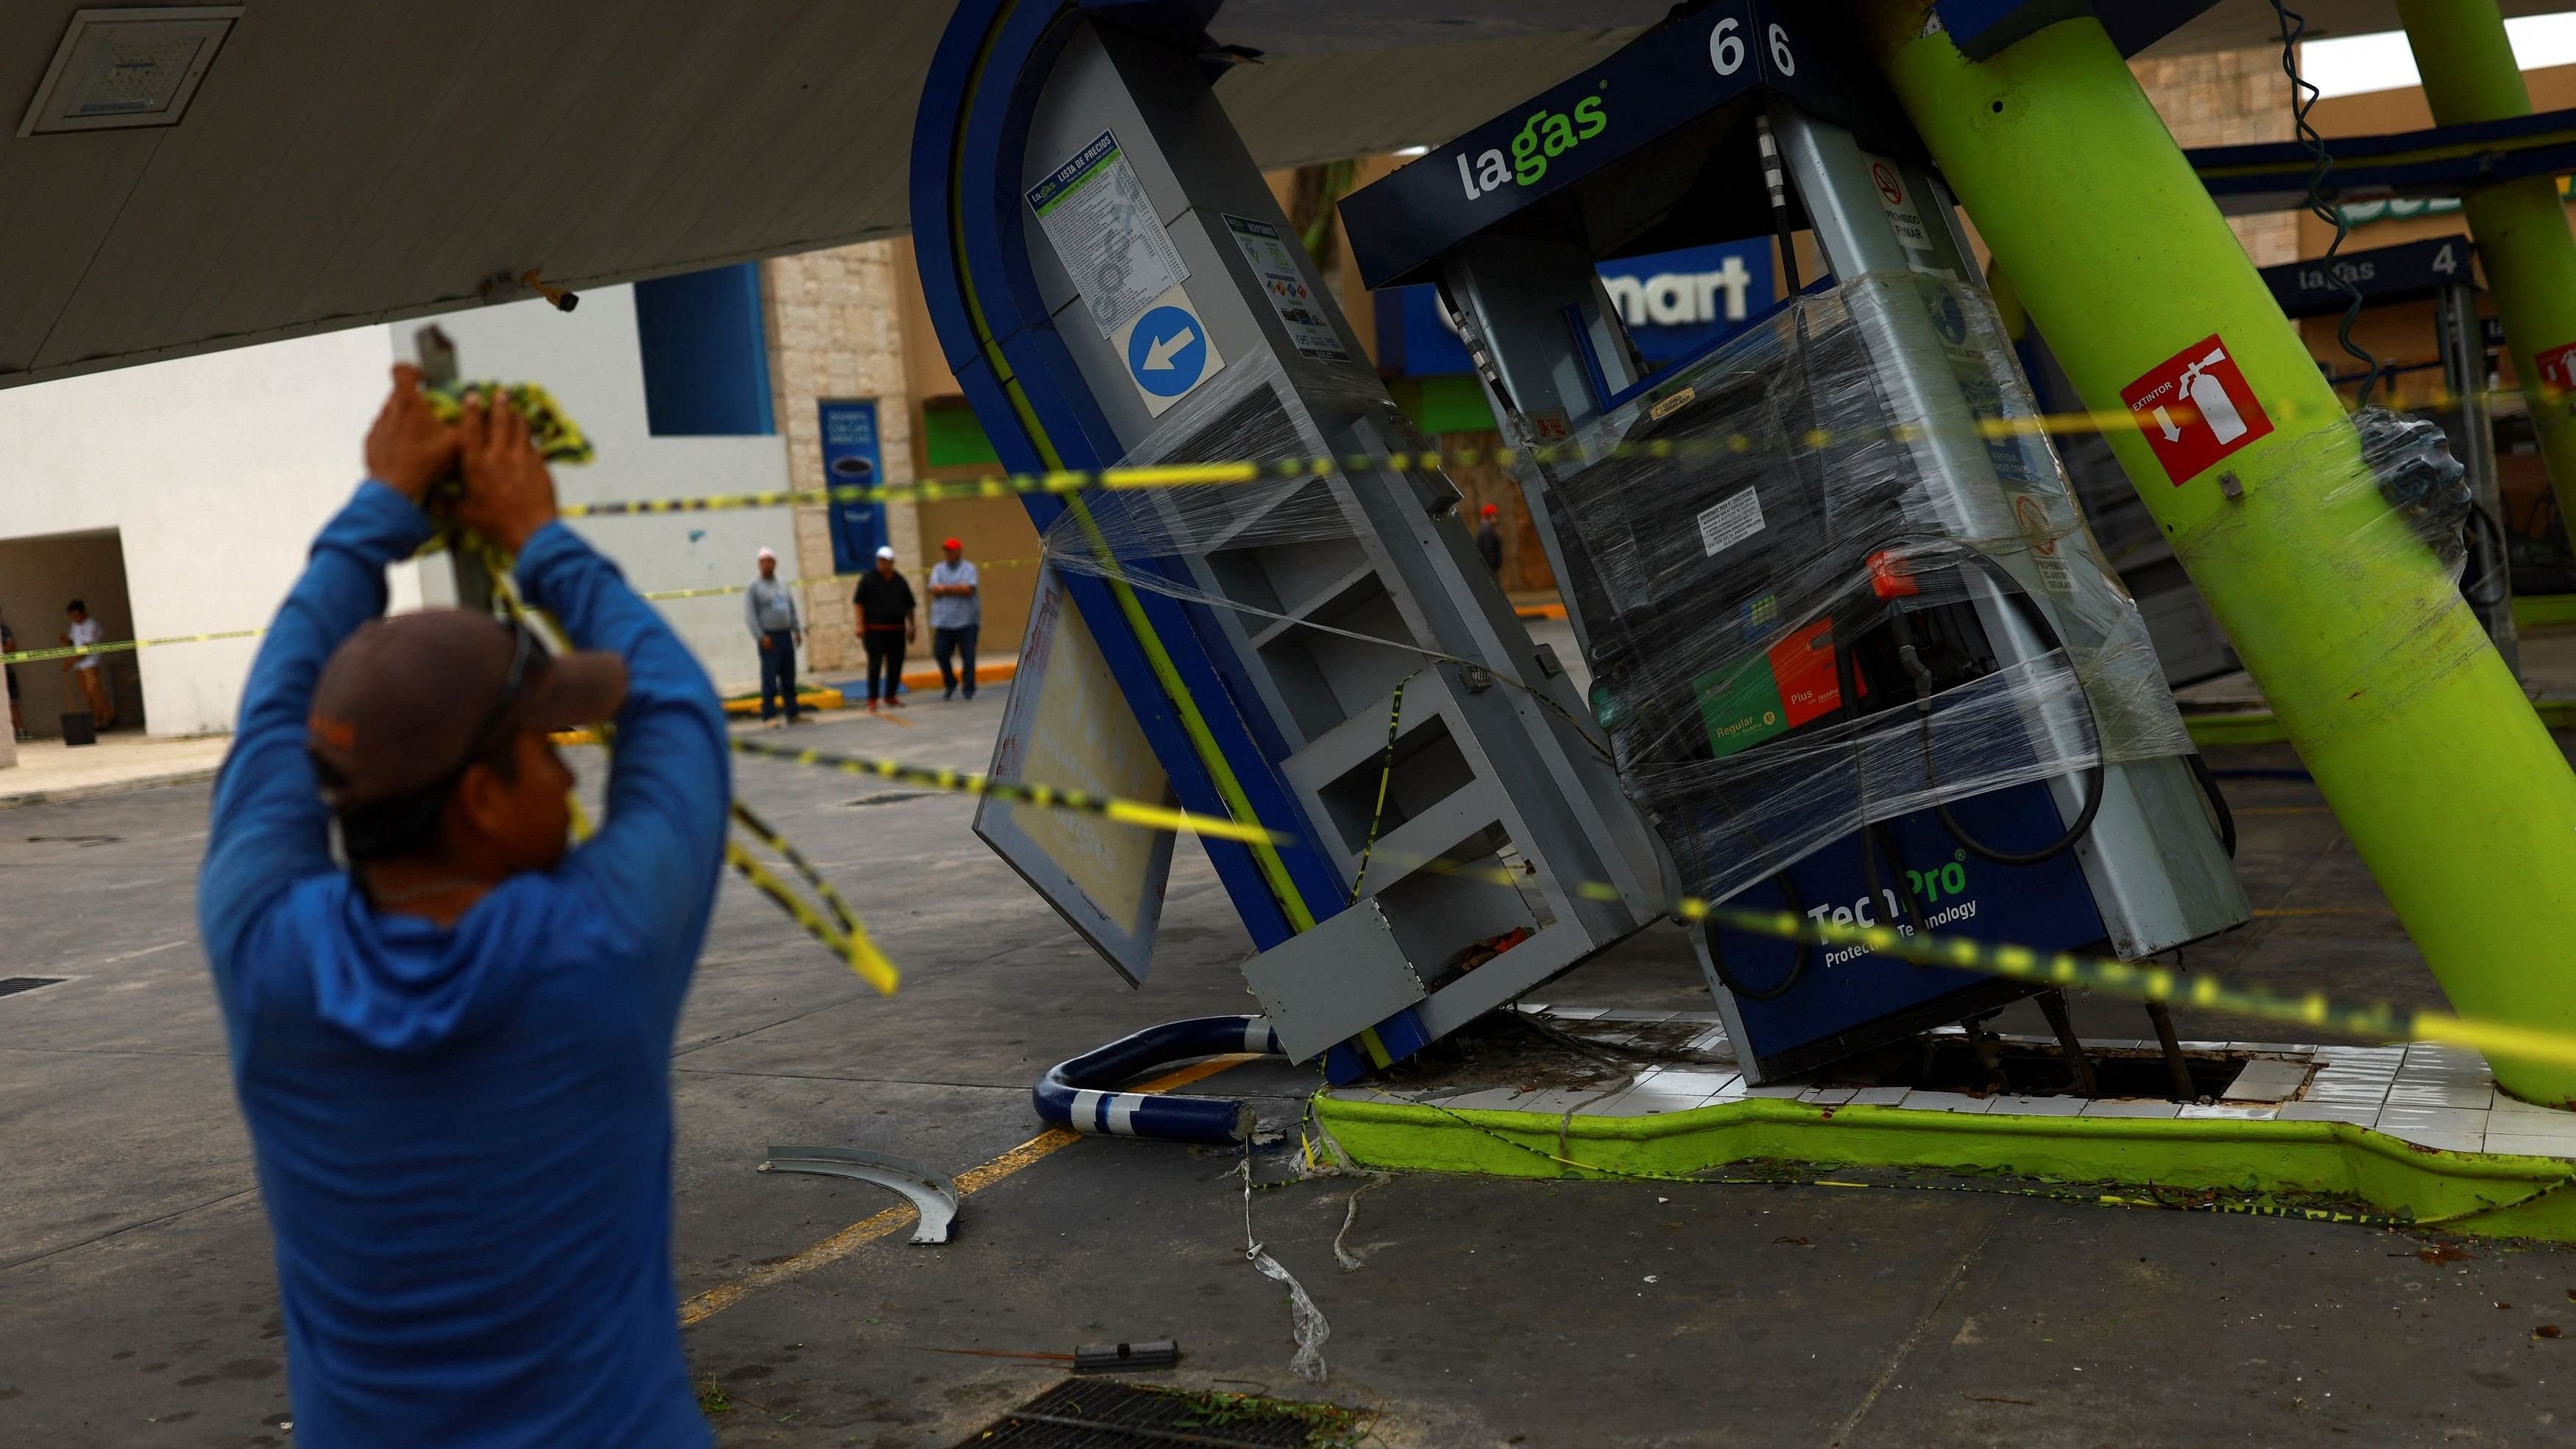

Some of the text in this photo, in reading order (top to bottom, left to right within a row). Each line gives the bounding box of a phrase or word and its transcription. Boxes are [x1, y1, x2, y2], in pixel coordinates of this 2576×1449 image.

[1710, 17, 1744, 76] 6
[1769, 23, 1795, 77] 6
[1031, 182, 1056, 202] lagas
[1058, 163, 1076, 183] LISTA
[1074, 157, 1086, 169] DE
[1084, 135, 1111, 161] PRECIOS
[1457, 96, 1607, 200] lagas
[2432, 243, 2458, 274] 4
[2132, 381, 2173, 412] EXTINTOR
[1791, 690, 1814, 705] Plus
[1716, 716, 1754, 738] Regular
